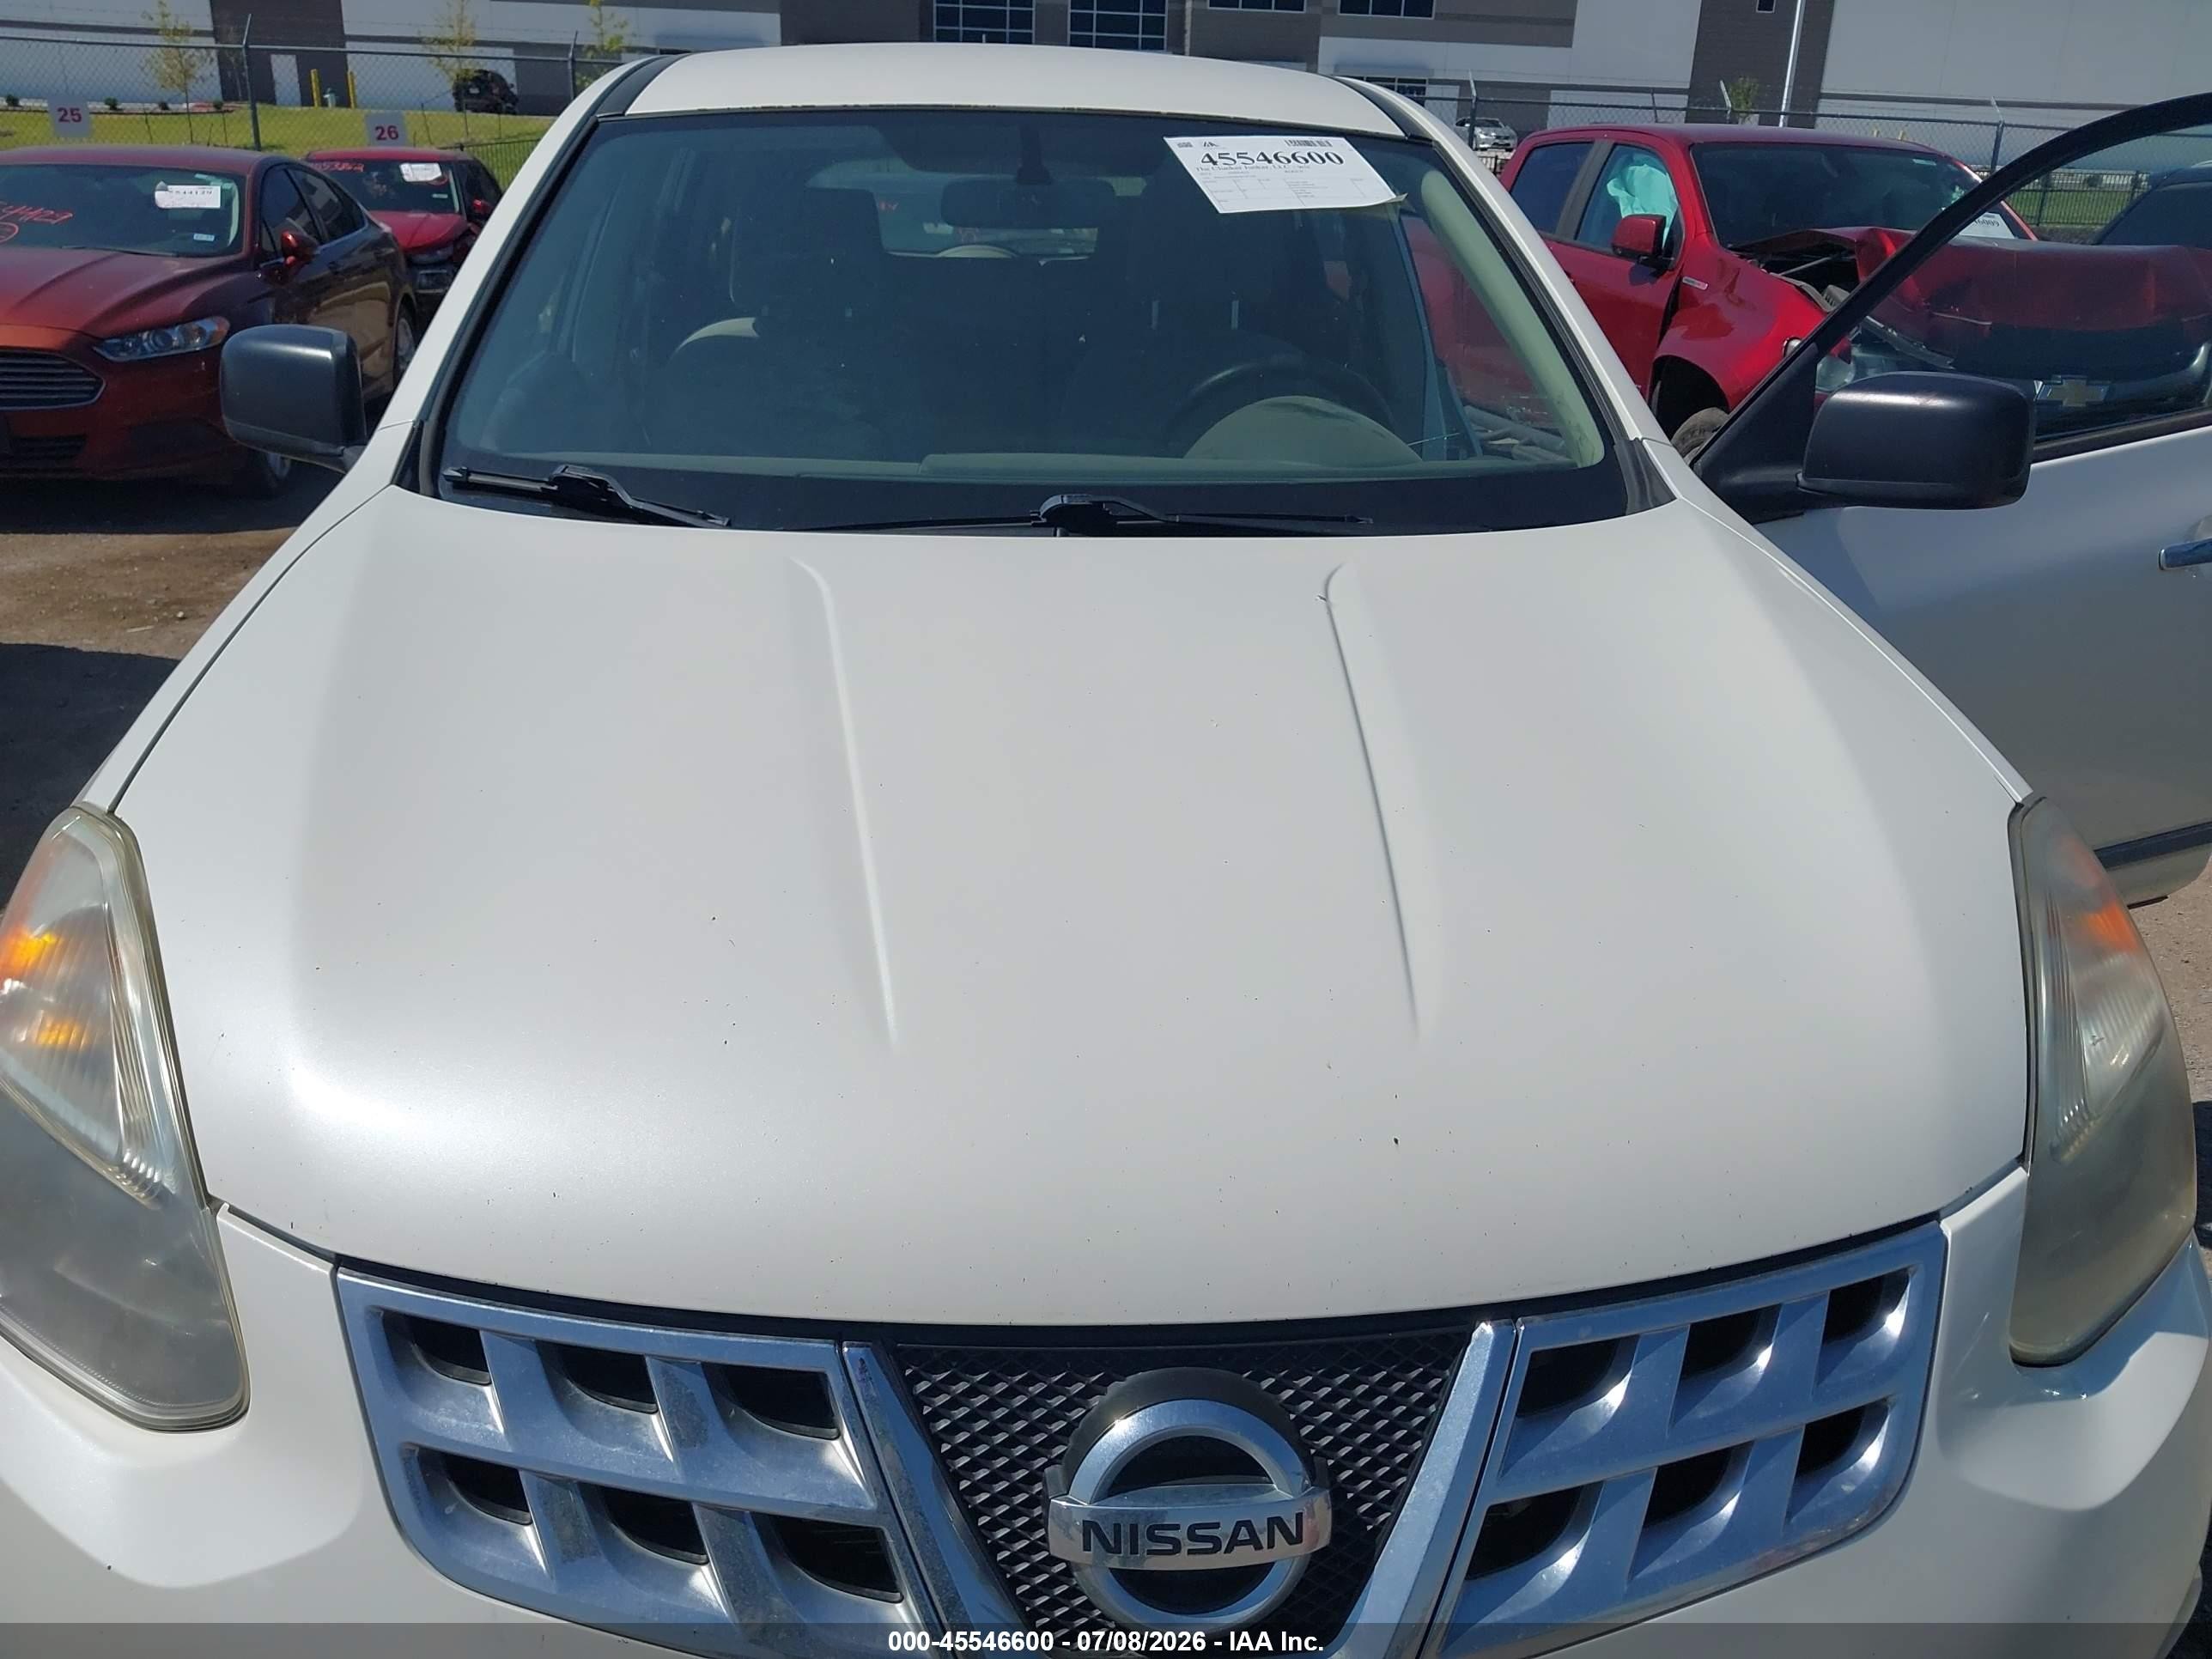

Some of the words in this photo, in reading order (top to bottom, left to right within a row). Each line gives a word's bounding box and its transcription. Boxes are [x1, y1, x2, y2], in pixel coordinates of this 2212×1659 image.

[58, 107, 82, 123] 25
[375, 125, 398, 141] 26
[1200, 150, 1345, 166] 45546600
[1082, 1511, 1303, 1556] NISSAN
